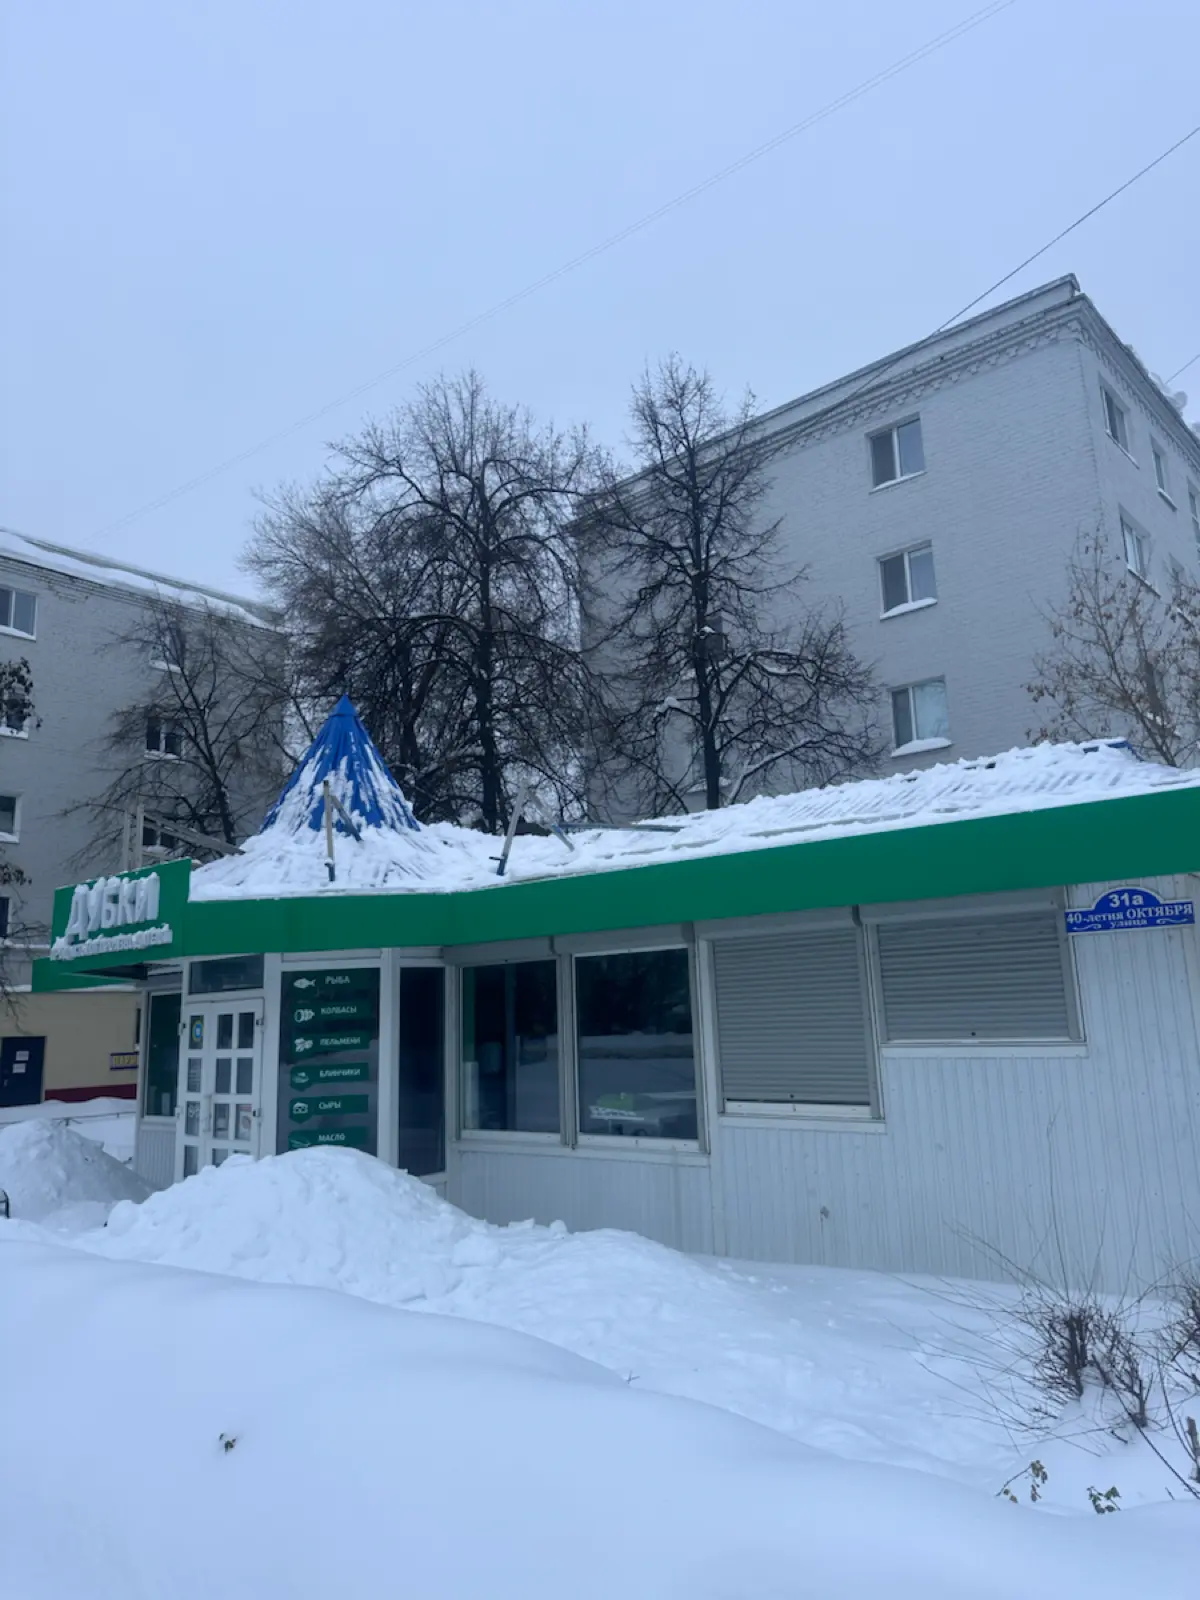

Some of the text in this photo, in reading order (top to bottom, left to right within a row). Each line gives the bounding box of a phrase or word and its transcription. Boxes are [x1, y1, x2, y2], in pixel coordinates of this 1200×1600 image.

[1108, 892, 1144, 908] 31а
[64, 872, 161, 944] ДУБКИ
[1066, 904, 1193, 924] 40-летия ОКТЯБРЯ
[1110, 919, 1148, 929] улица
[325, 975, 351, 985] РЫБА
[320, 1006, 357, 1015] КОЛБАСЫ
[319, 1036, 361, 1046] ПЕЛЬМЕНИ
[319, 1068, 361, 1078] БЛИНЧИКИ
[318, 1100, 342, 1110] СЫРЫ
[318, 1133, 346, 1142] МАСЛО
